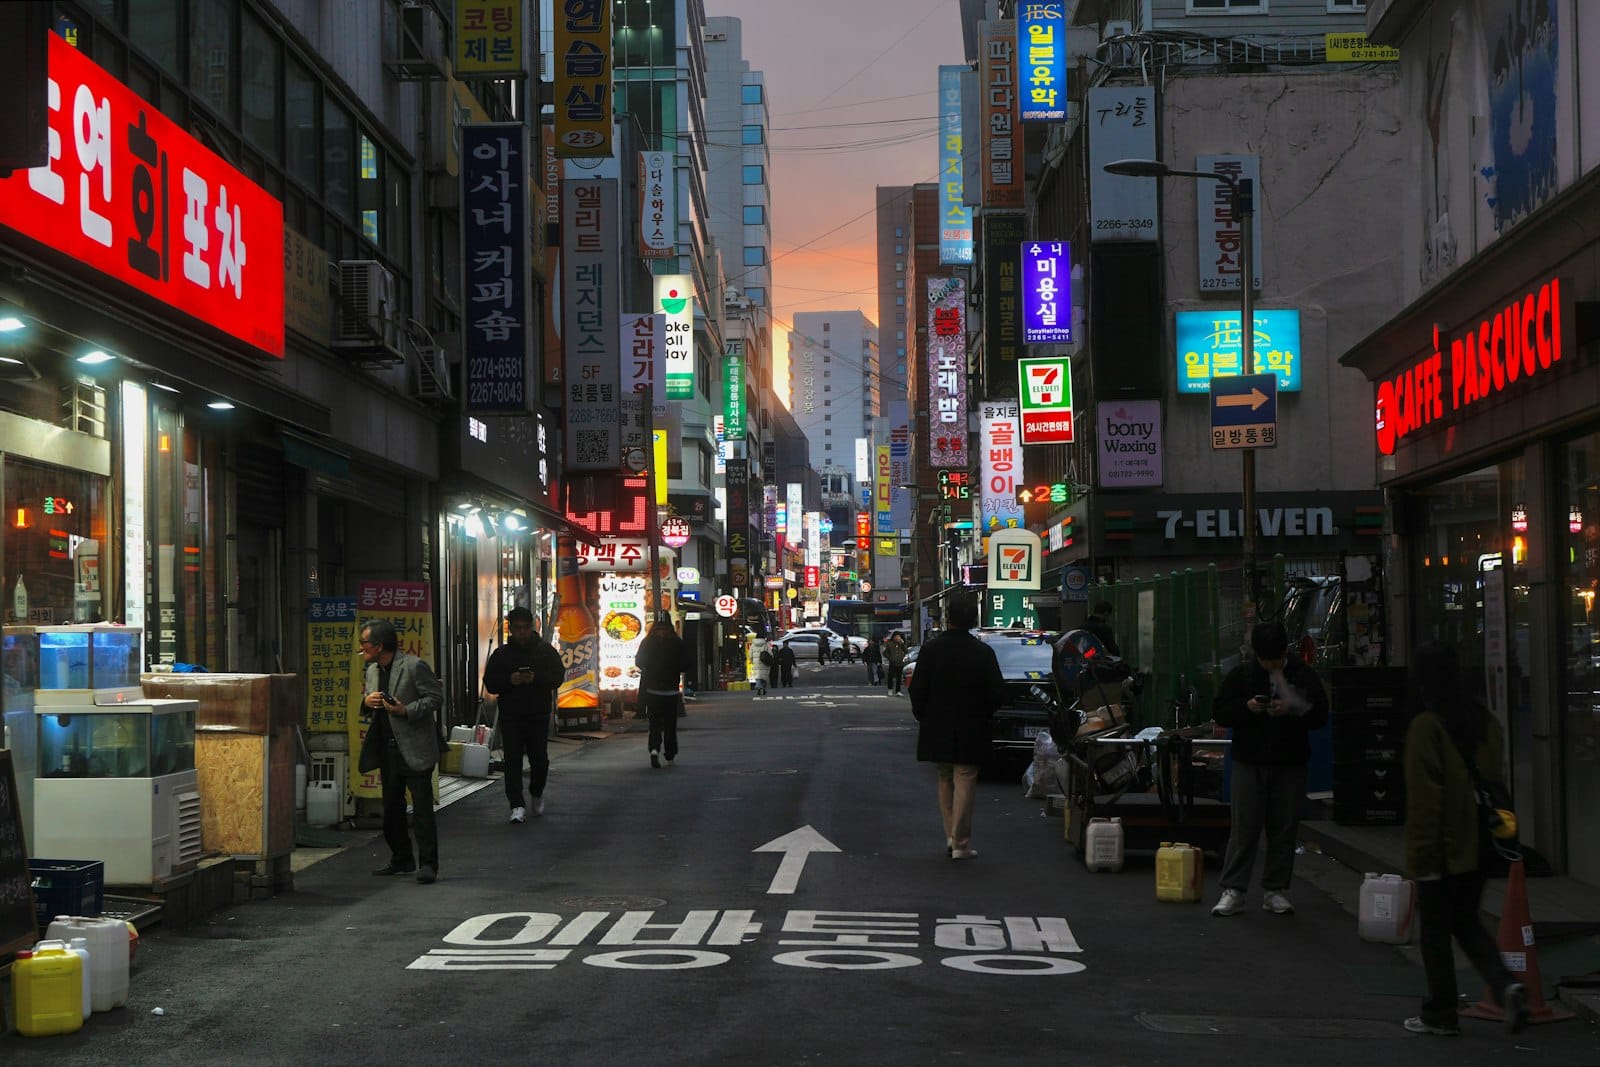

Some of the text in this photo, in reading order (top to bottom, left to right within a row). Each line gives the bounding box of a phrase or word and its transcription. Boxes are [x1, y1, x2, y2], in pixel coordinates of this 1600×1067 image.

[464, 7, 513, 32] 코팅
[1025, 4, 1060, 23] JEC
[464, 37, 514, 62] 제본
[1028, 25, 1058, 107] 일본유학
[567, 132, 598, 146] 2층
[127, 110, 169, 283] 회
[183, 166, 246, 300] 포차
[651, 169, 665, 240] 다솔하우스
[1097, 219, 1153, 230] 2266-3349
[1030, 243, 1063, 256] 수니
[575, 186, 605, 354] 엘리트 레지던스
[472, 246, 521, 343] 커피숍
[1036, 257, 1058, 326] 미용실
[665, 322, 690, 332] oke
[726, 344, 741, 354] 7F
[1450, 277, 1562, 411] PASCUCCI
[581, 365, 601, 379] 5F
[570, 383, 613, 403] 원룸텔
[984, 406, 1018, 418] 을지로
[1106, 417, 1154, 440] bony
[1213, 427, 1275, 446] 일방통행
[1104, 439, 1157, 455] Waxing
[988, 422, 1015, 494] 골뱅이
[1034, 482, 1067, 503] 2층
[984, 498, 1020, 514] 치킨
[678, 568, 695, 580] CU
[361, 587, 426, 608] 동성문구
[719, 598, 735, 614] 약
[993, 596, 1035, 611] 담배
[559, 640, 593, 669] ass
[406, 909, 1087, 976] 일방통행
